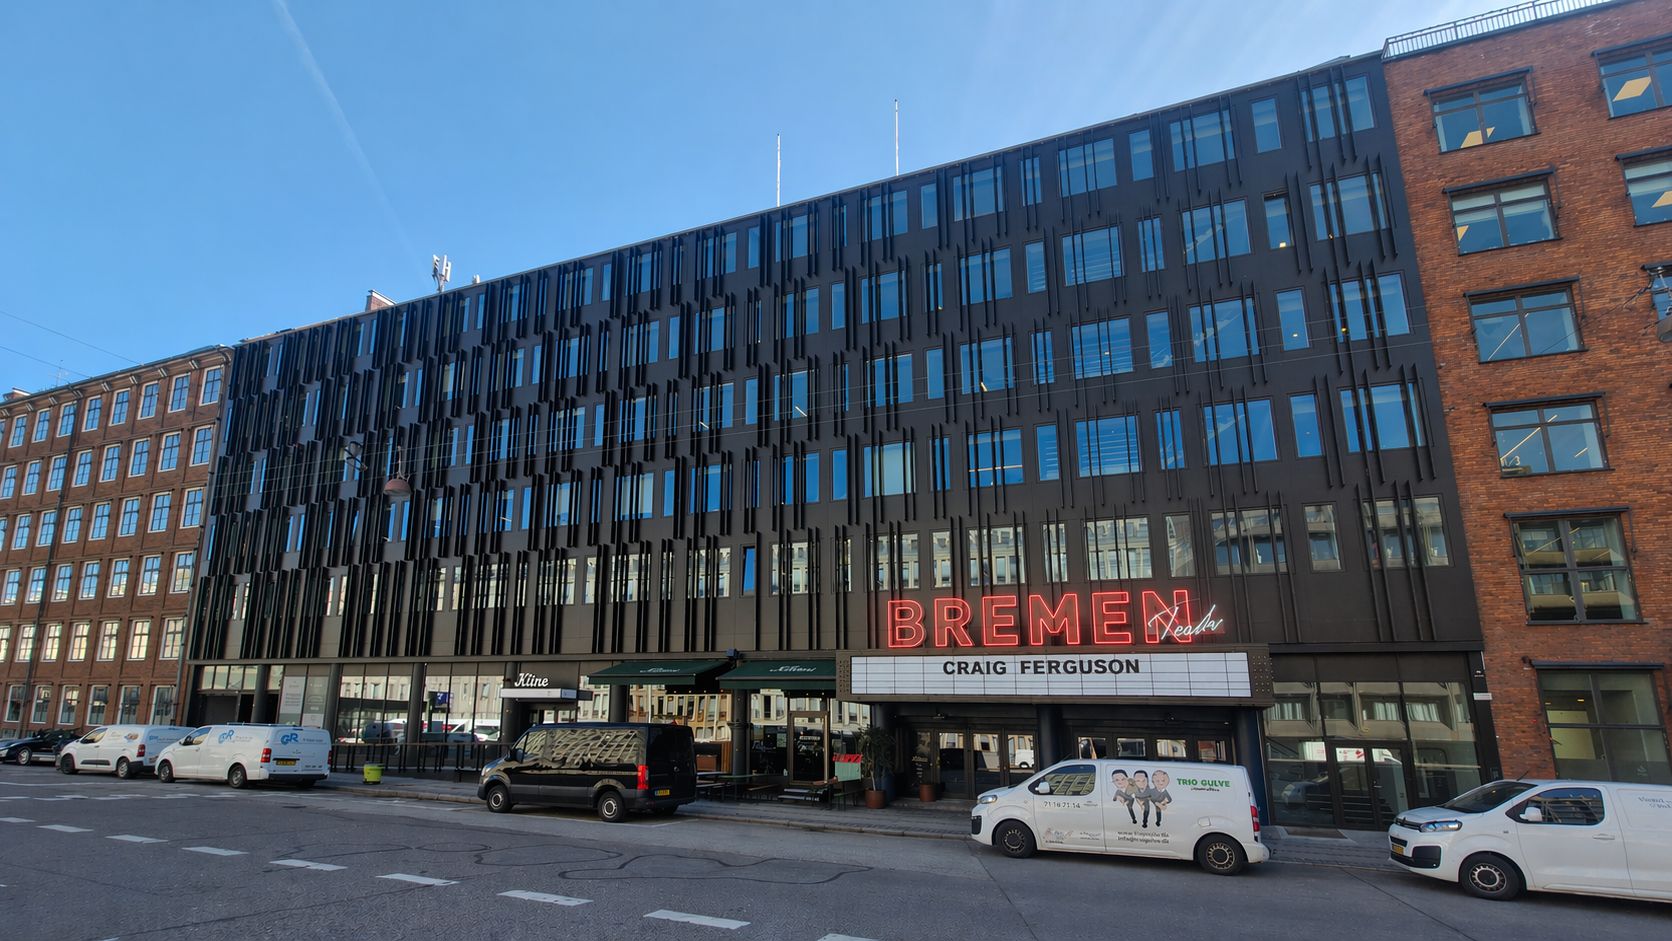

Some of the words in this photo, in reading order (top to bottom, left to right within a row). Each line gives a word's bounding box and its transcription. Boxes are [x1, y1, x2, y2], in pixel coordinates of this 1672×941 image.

[887, 589, 1193, 649] BREMEN
[943, 660, 1007, 676] CRAIG
[1020, 658, 1140, 676] FERGUSON
[280, 732, 299, 746] GR
[1176, 777, 1198, 786] TRIO
[1200, 779, 1231, 788] GULVE
